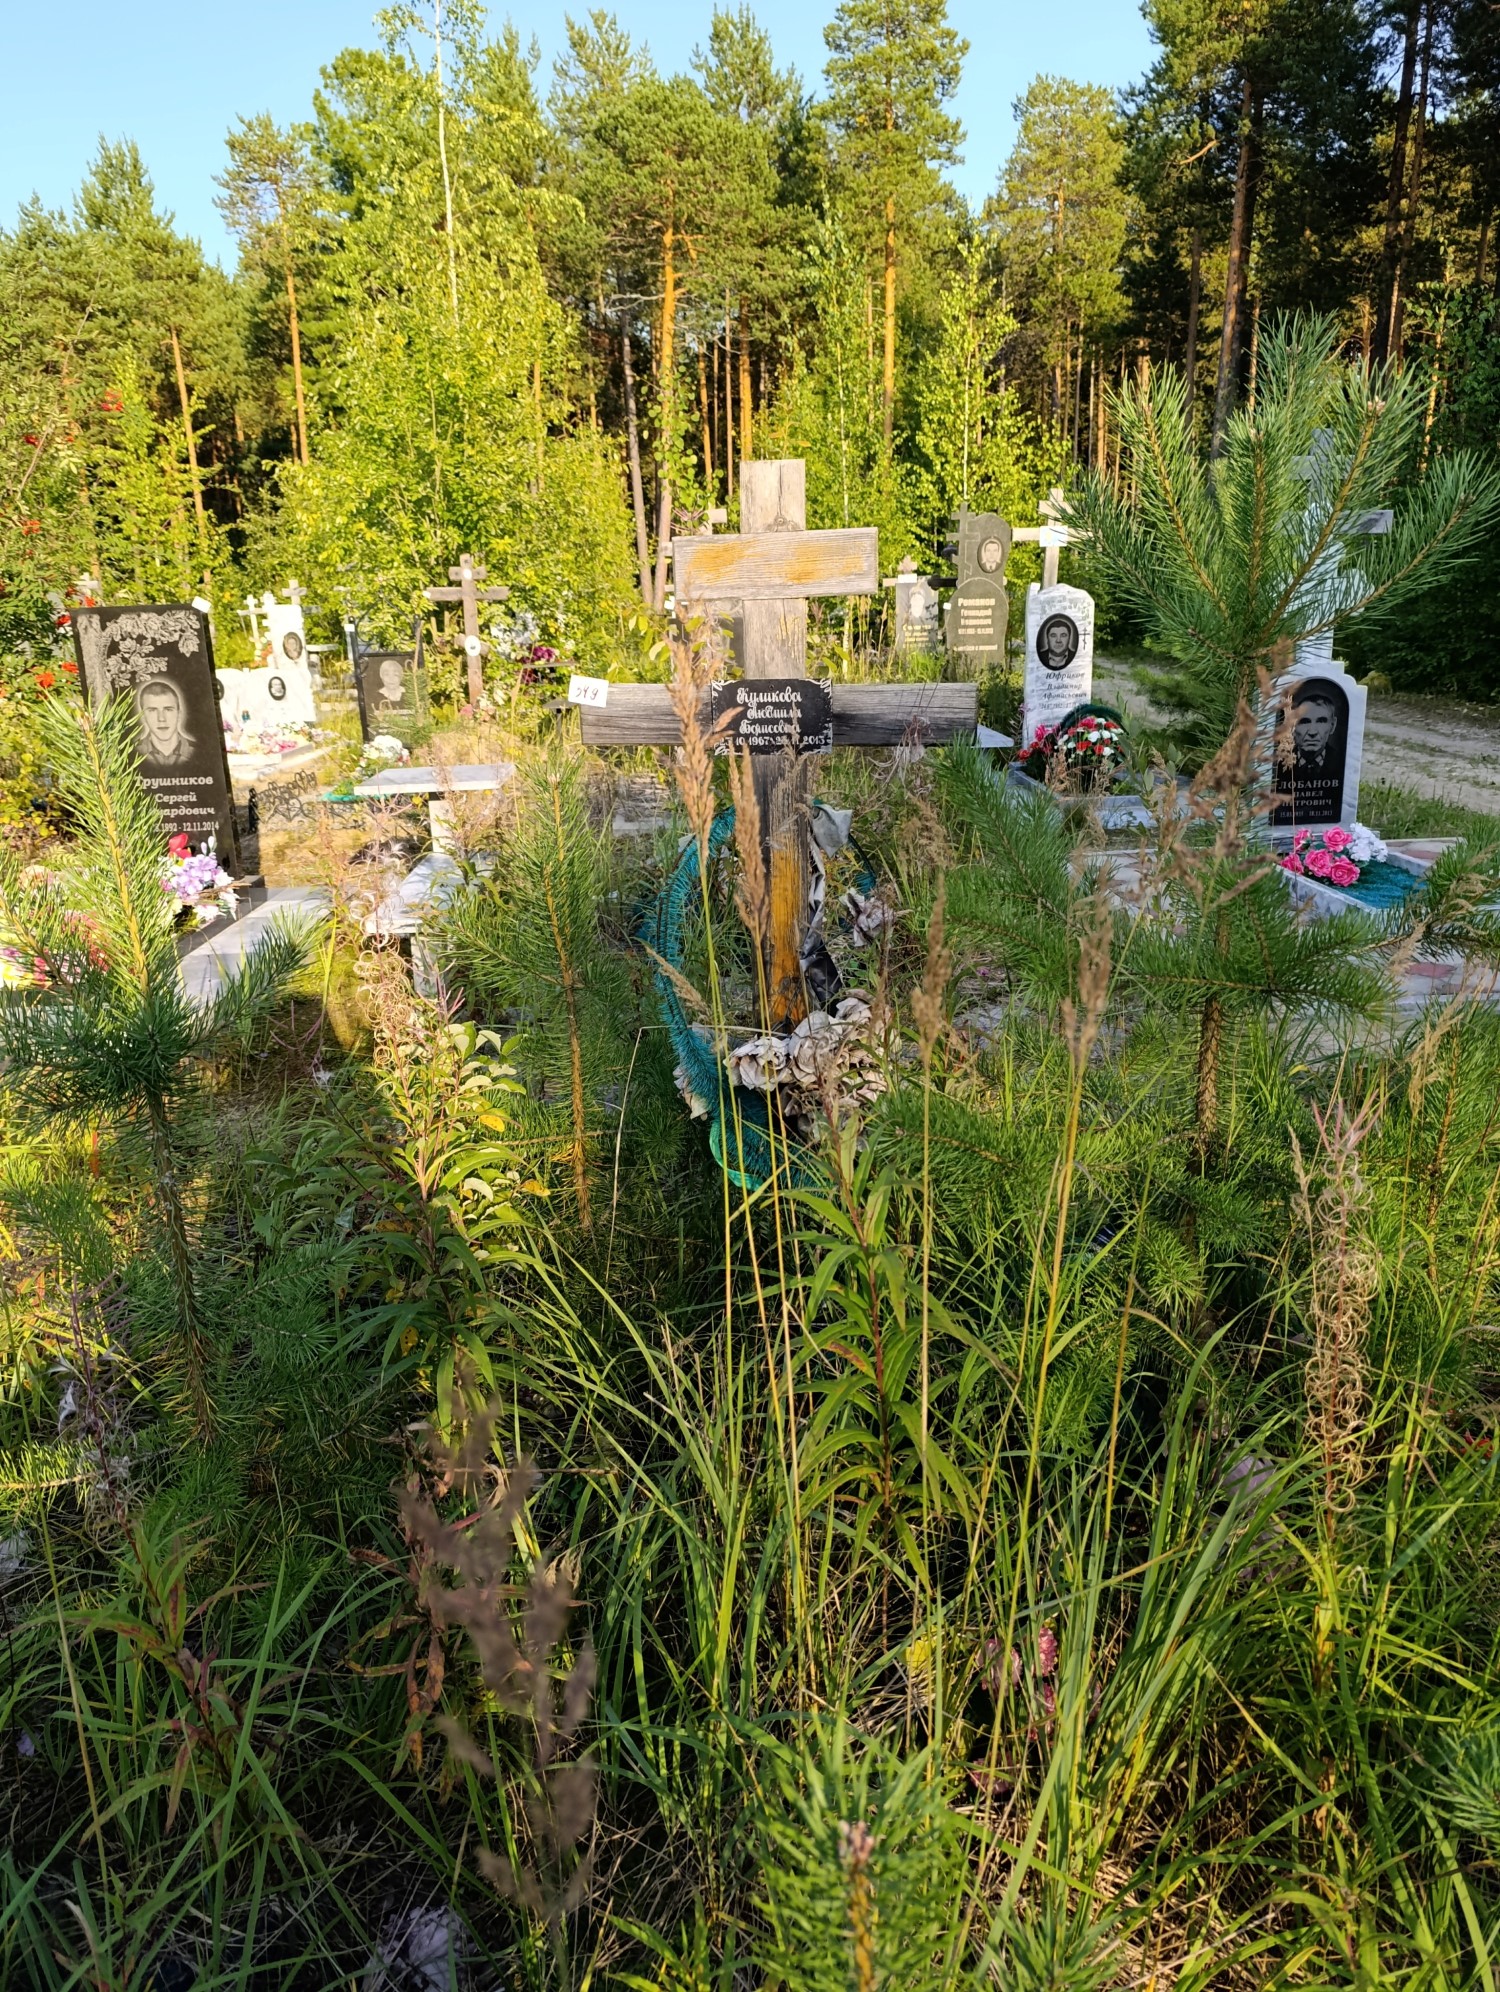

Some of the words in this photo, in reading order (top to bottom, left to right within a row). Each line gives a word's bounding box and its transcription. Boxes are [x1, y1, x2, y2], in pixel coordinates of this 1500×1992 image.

[736, 686, 803, 707] Куликова
[739, 719, 801, 736] Борисова
[1278, 779, 1339, 790] ЛОБАНОВ
[155, 792, 198, 804] Сергей
